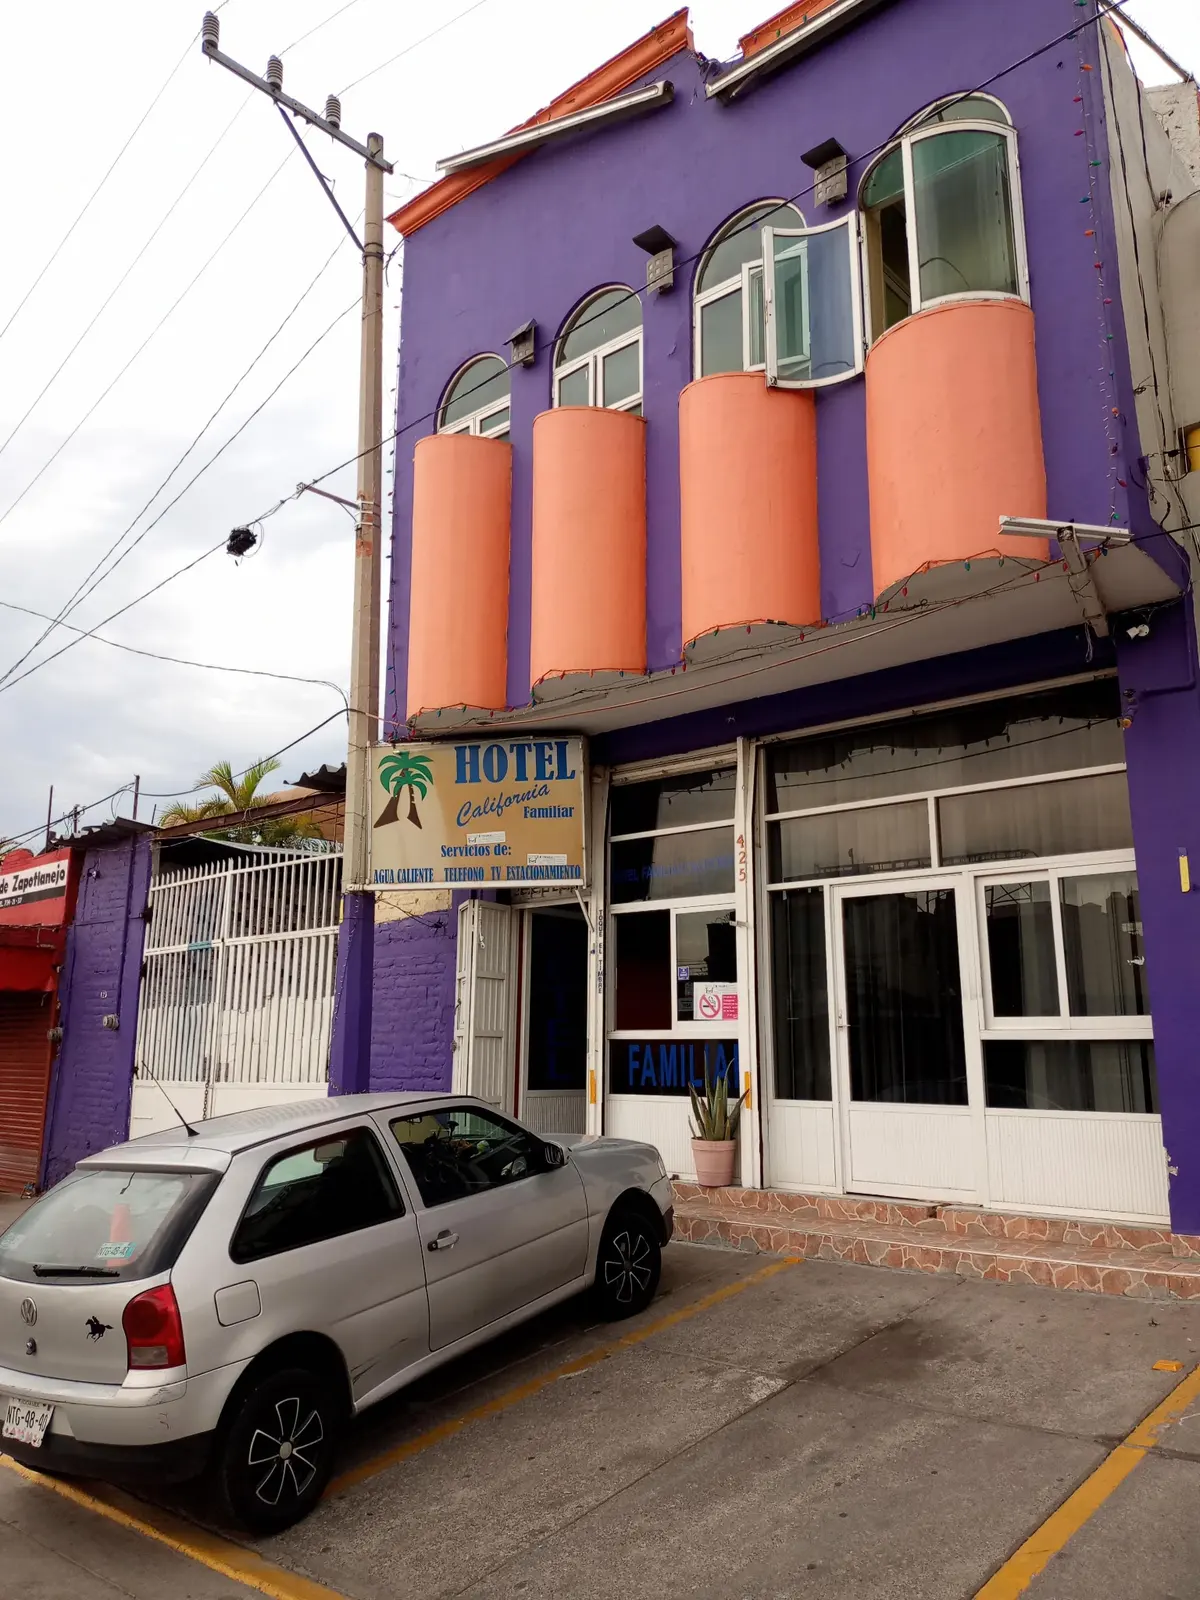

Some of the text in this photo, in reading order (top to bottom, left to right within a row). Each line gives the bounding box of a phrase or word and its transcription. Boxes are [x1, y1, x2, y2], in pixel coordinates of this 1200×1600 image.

[454, 741, 576, 784] HOTEL
[456, 784, 551, 827] California
[523, 805, 575, 819] Familiar
[441, 843, 512, 858] Servicios de:
[12, 864, 66, 893] Zapotlanejo
[373, 864, 581, 884] AGUA CALIENTE TELEFONO TV ESTACIONAMIENTO
